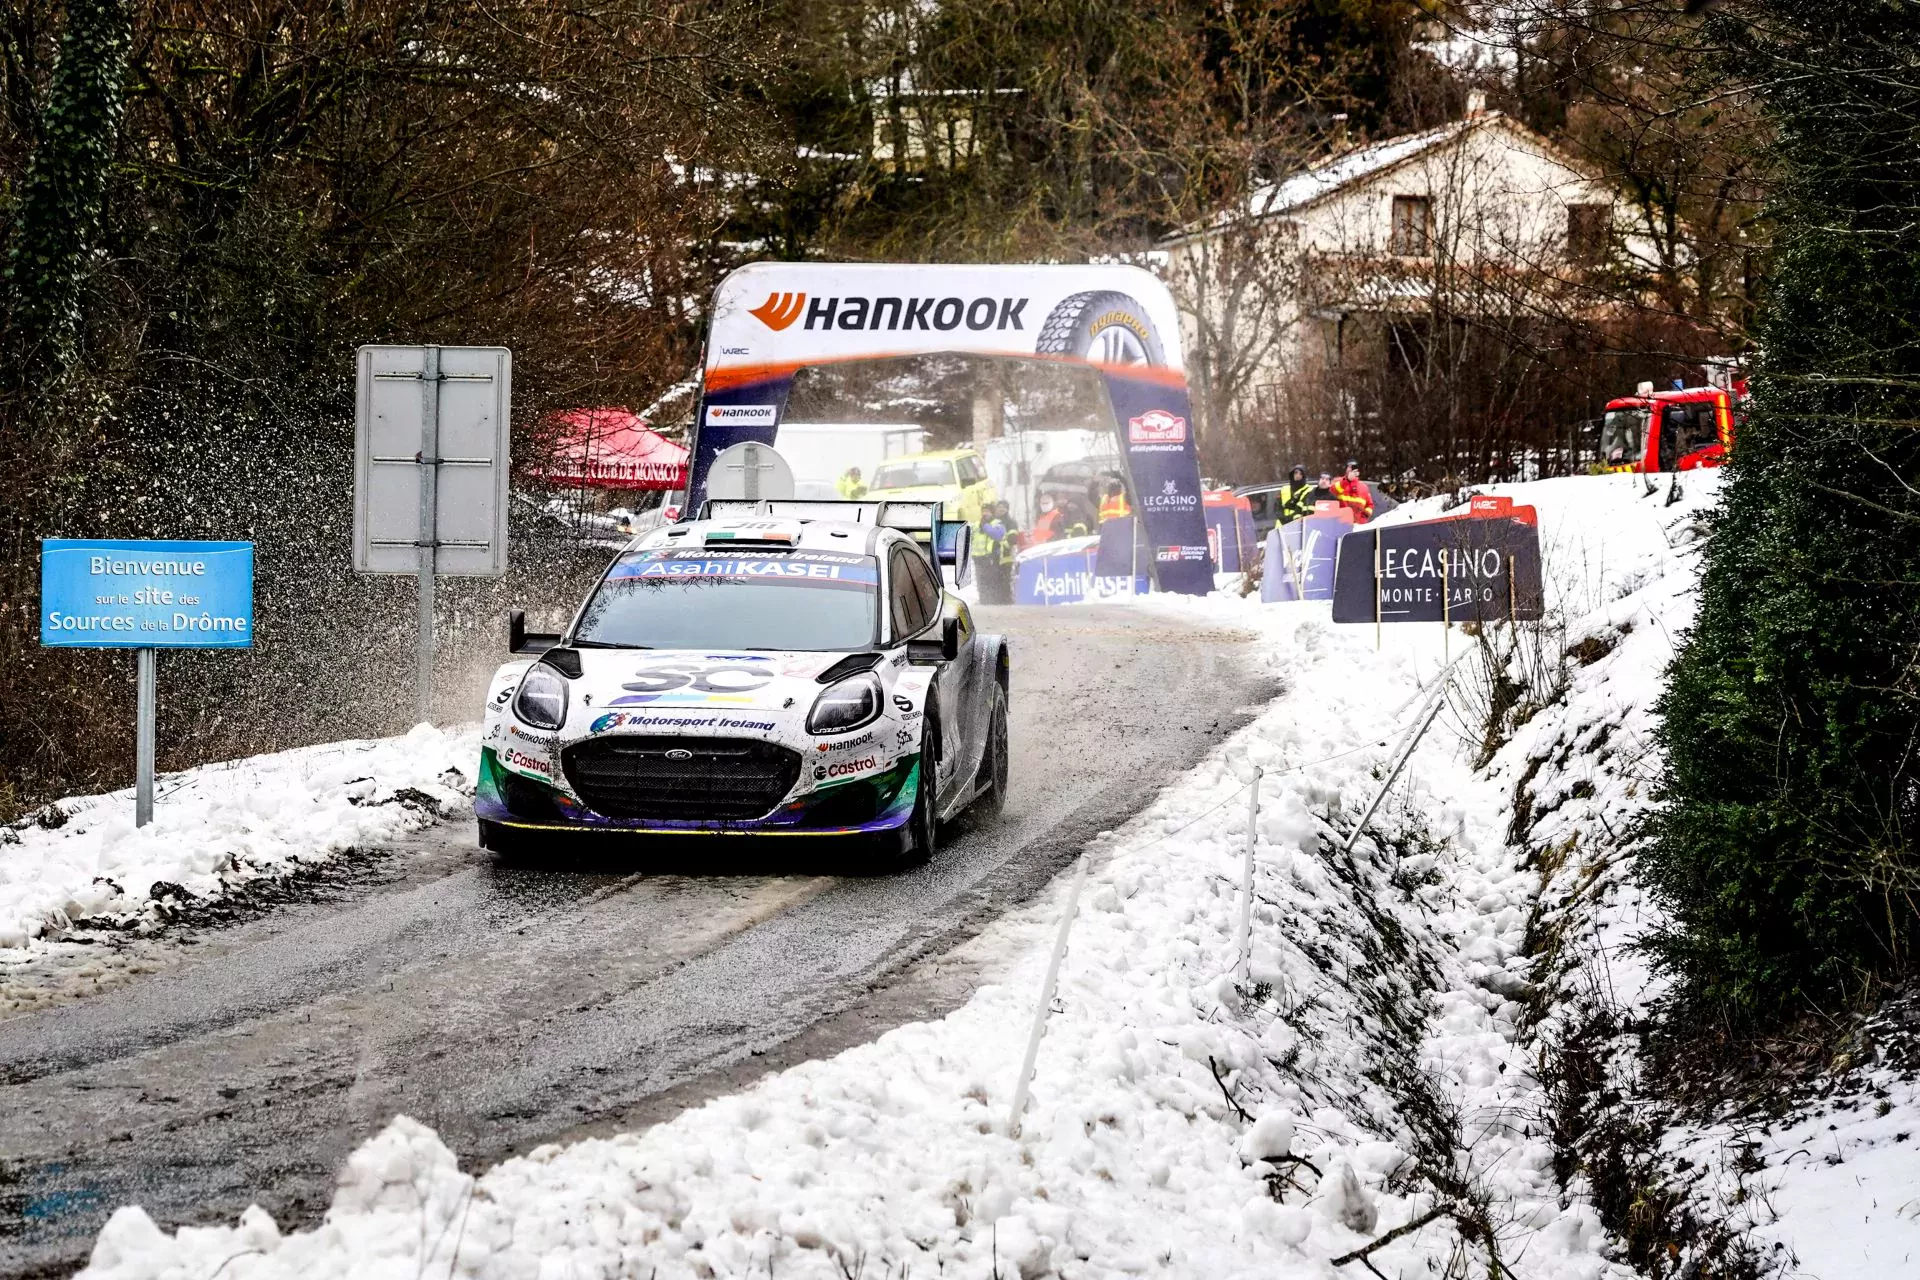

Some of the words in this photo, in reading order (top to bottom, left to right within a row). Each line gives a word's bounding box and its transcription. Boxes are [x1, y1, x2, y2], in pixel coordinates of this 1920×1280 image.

[619, 463, 634, 480] DE
[634, 463, 680, 481] MONACO
[1144, 496, 1154, 506] LE
[1155, 495, 1197, 506] CASINO
[1472, 499, 1499, 510] WRC
[89, 556, 206, 576] Bienvenue
[673, 550, 790, 561] Motorsport
[791, 551, 864, 565] Ireland
[1402, 548, 1501, 579] CASINO
[95, 595, 116, 605] sur
[117, 593, 129, 605] le
[133, 586, 174, 606] site
[178, 593, 200, 606] des
[48, 611, 135, 632] Sources
[139, 620, 155, 632] de
[157, 620, 169, 632] la
[172, 611, 247, 632] Drôme
[628, 715, 717, 728] Motorsport
[719, 717, 776, 731] Ireland
[512, 752, 551, 774] Castrol
[828, 755, 877, 778] Castrol
